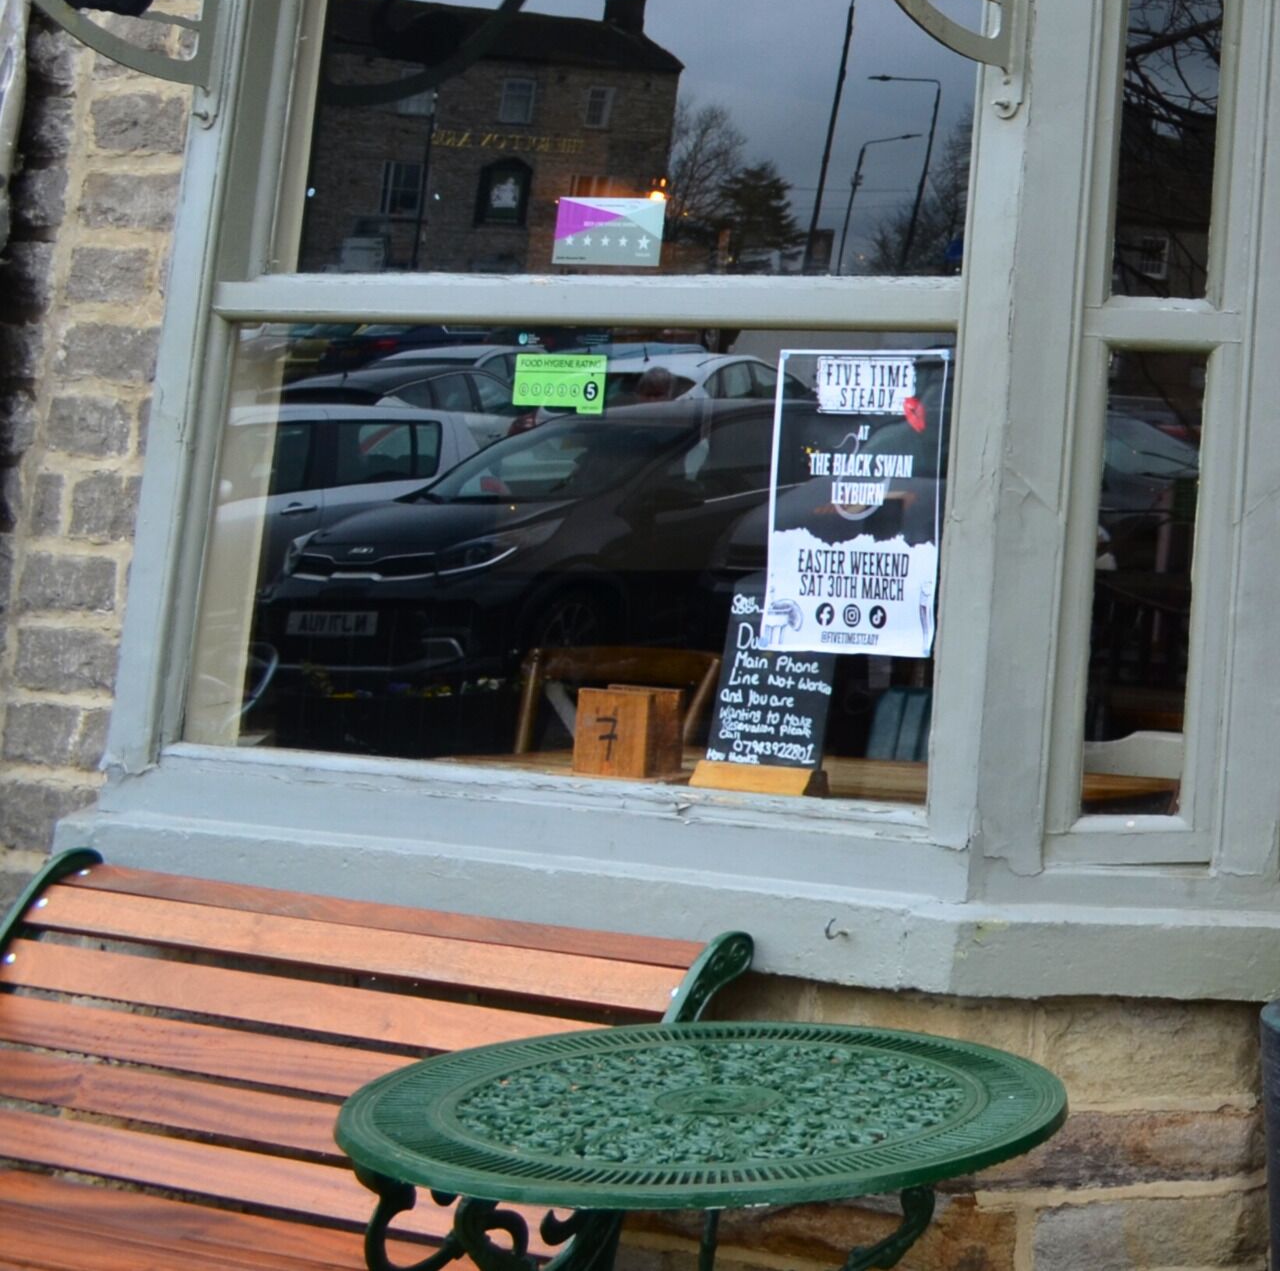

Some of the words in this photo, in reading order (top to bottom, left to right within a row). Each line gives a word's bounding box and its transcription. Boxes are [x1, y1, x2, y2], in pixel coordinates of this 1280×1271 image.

[520, 359, 543, 368] FOOD
[543, 359, 574, 369] HYGIENE
[826, 363, 861, 386] FIVE
[870, 364, 909, 388] TIME
[586, 383, 596, 399] 5
[839, 387, 896, 409] STEADY
[857, 425, 870, 441] AT
[809, 452, 831, 476] THE
[833, 453, 872, 477] BLACK
[874, 454, 914, 478] SWAN
[831, 481, 886, 506] LEYBURN
[797, 548, 845, 575] EASTER
[849, 550, 910, 578] WEEKEND
[798, 574, 824, 597] SAT
[827, 575, 858, 599] 30TH
[861, 576, 905, 601] MARCH
[820, 630, 879, 646] @FIVETIMESTEADY
[734, 650, 769, 669] Main
[775, 655, 820, 674] Phone
[728, 667, 760, 686] Line
[767, 674, 796, 689] Not
[769, 694, 795, 708] are
[766, 710, 780, 725] to
[596, 716, 618, 762] 7
